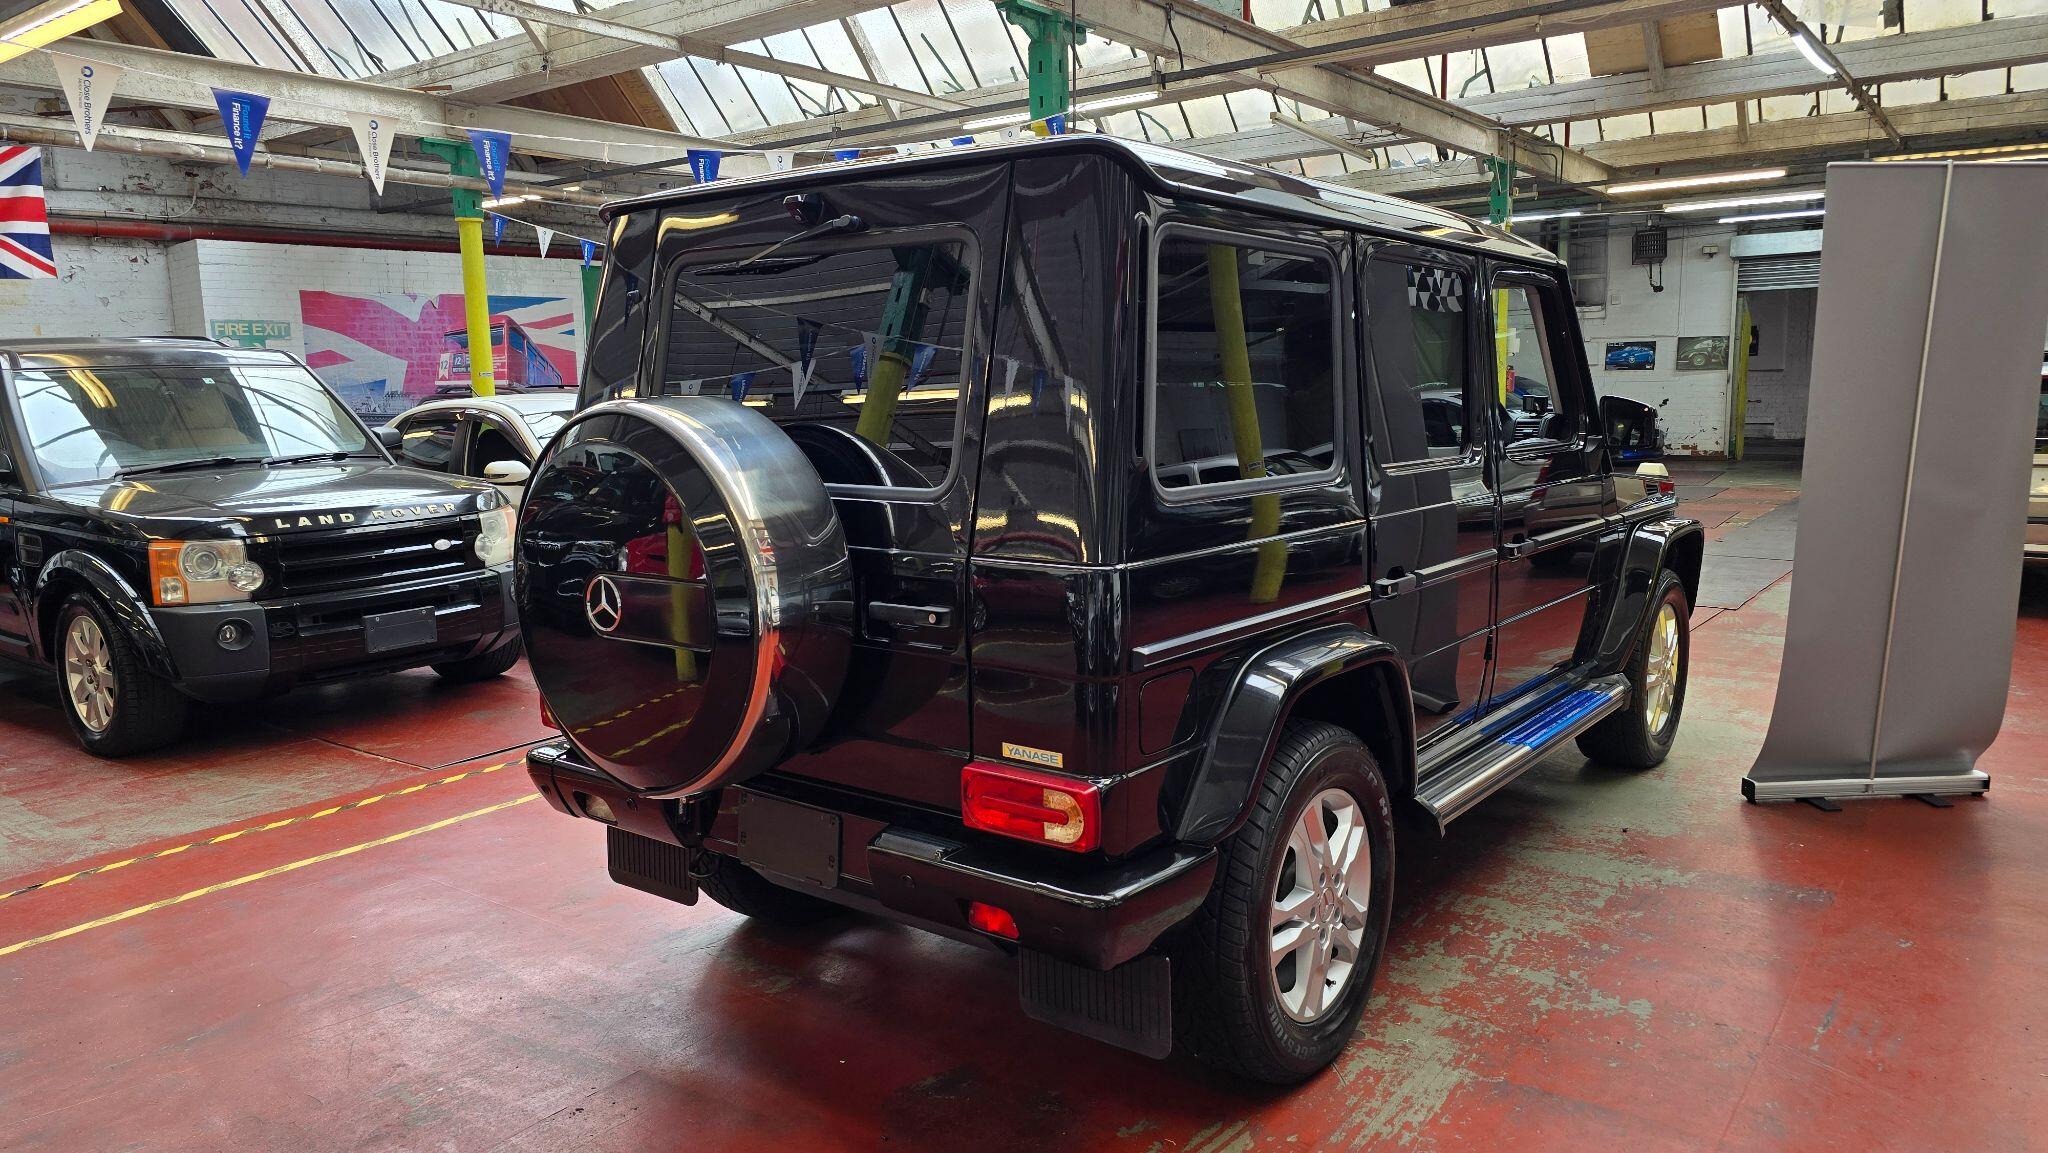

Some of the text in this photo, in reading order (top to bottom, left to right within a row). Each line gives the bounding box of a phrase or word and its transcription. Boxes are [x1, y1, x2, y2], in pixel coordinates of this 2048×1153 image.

[84, 80, 93, 135] Close Brothers
[242, 104, 251, 132] Found
[232, 102, 243, 150] Finance it?
[373, 151, 381, 180] Brothers
[483, 140, 492, 170] Finance
[491, 141, 499, 165] Found
[215, 322, 288, 336] FIRE EXIT
[275, 503, 457, 529] LAND ROVER
[1006, 745, 1059, 764] YANASE
